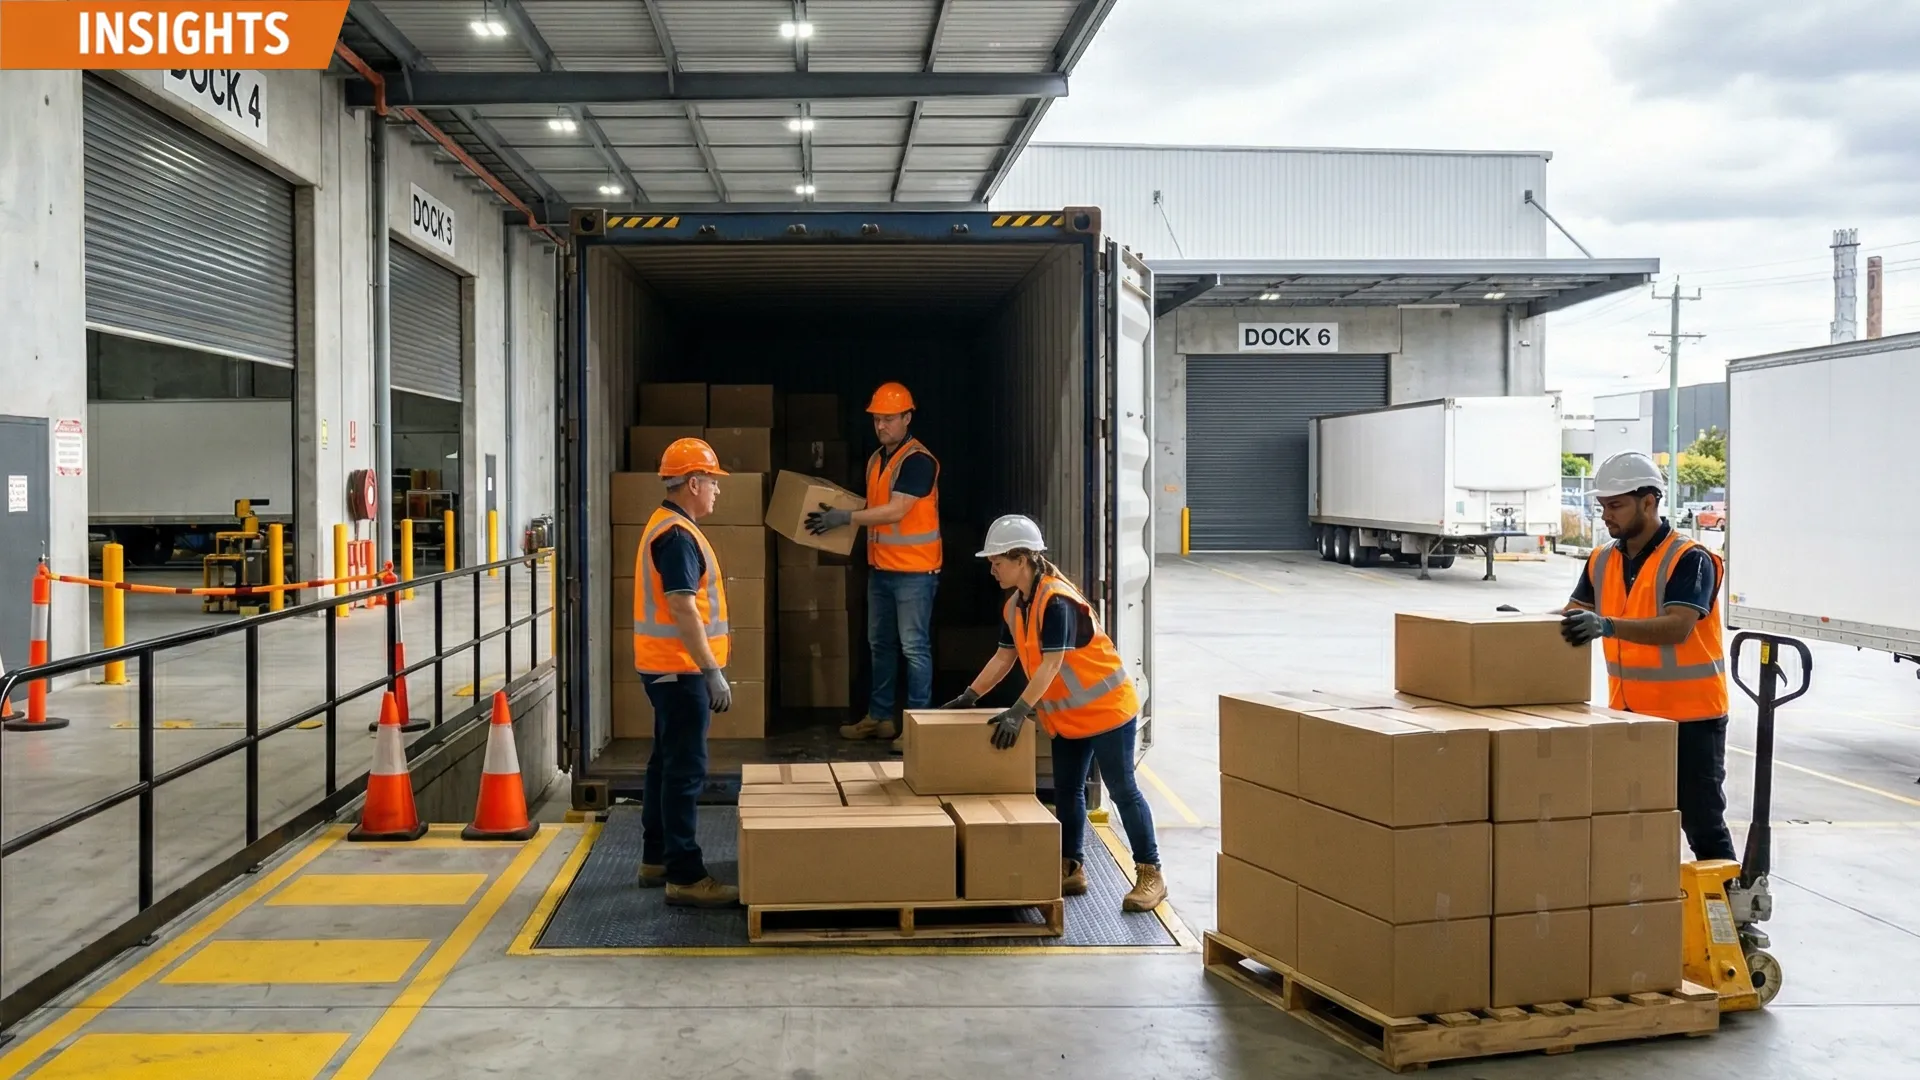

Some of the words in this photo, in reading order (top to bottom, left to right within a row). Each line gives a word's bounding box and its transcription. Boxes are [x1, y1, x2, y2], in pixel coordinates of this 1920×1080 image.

[170, 69, 243, 119] OCK
[248, 84, 261, 128] 4
[413, 193, 445, 243] DOCK
[1245, 328, 1311, 346] DOCK
[1317, 328, 1331, 346] 6
